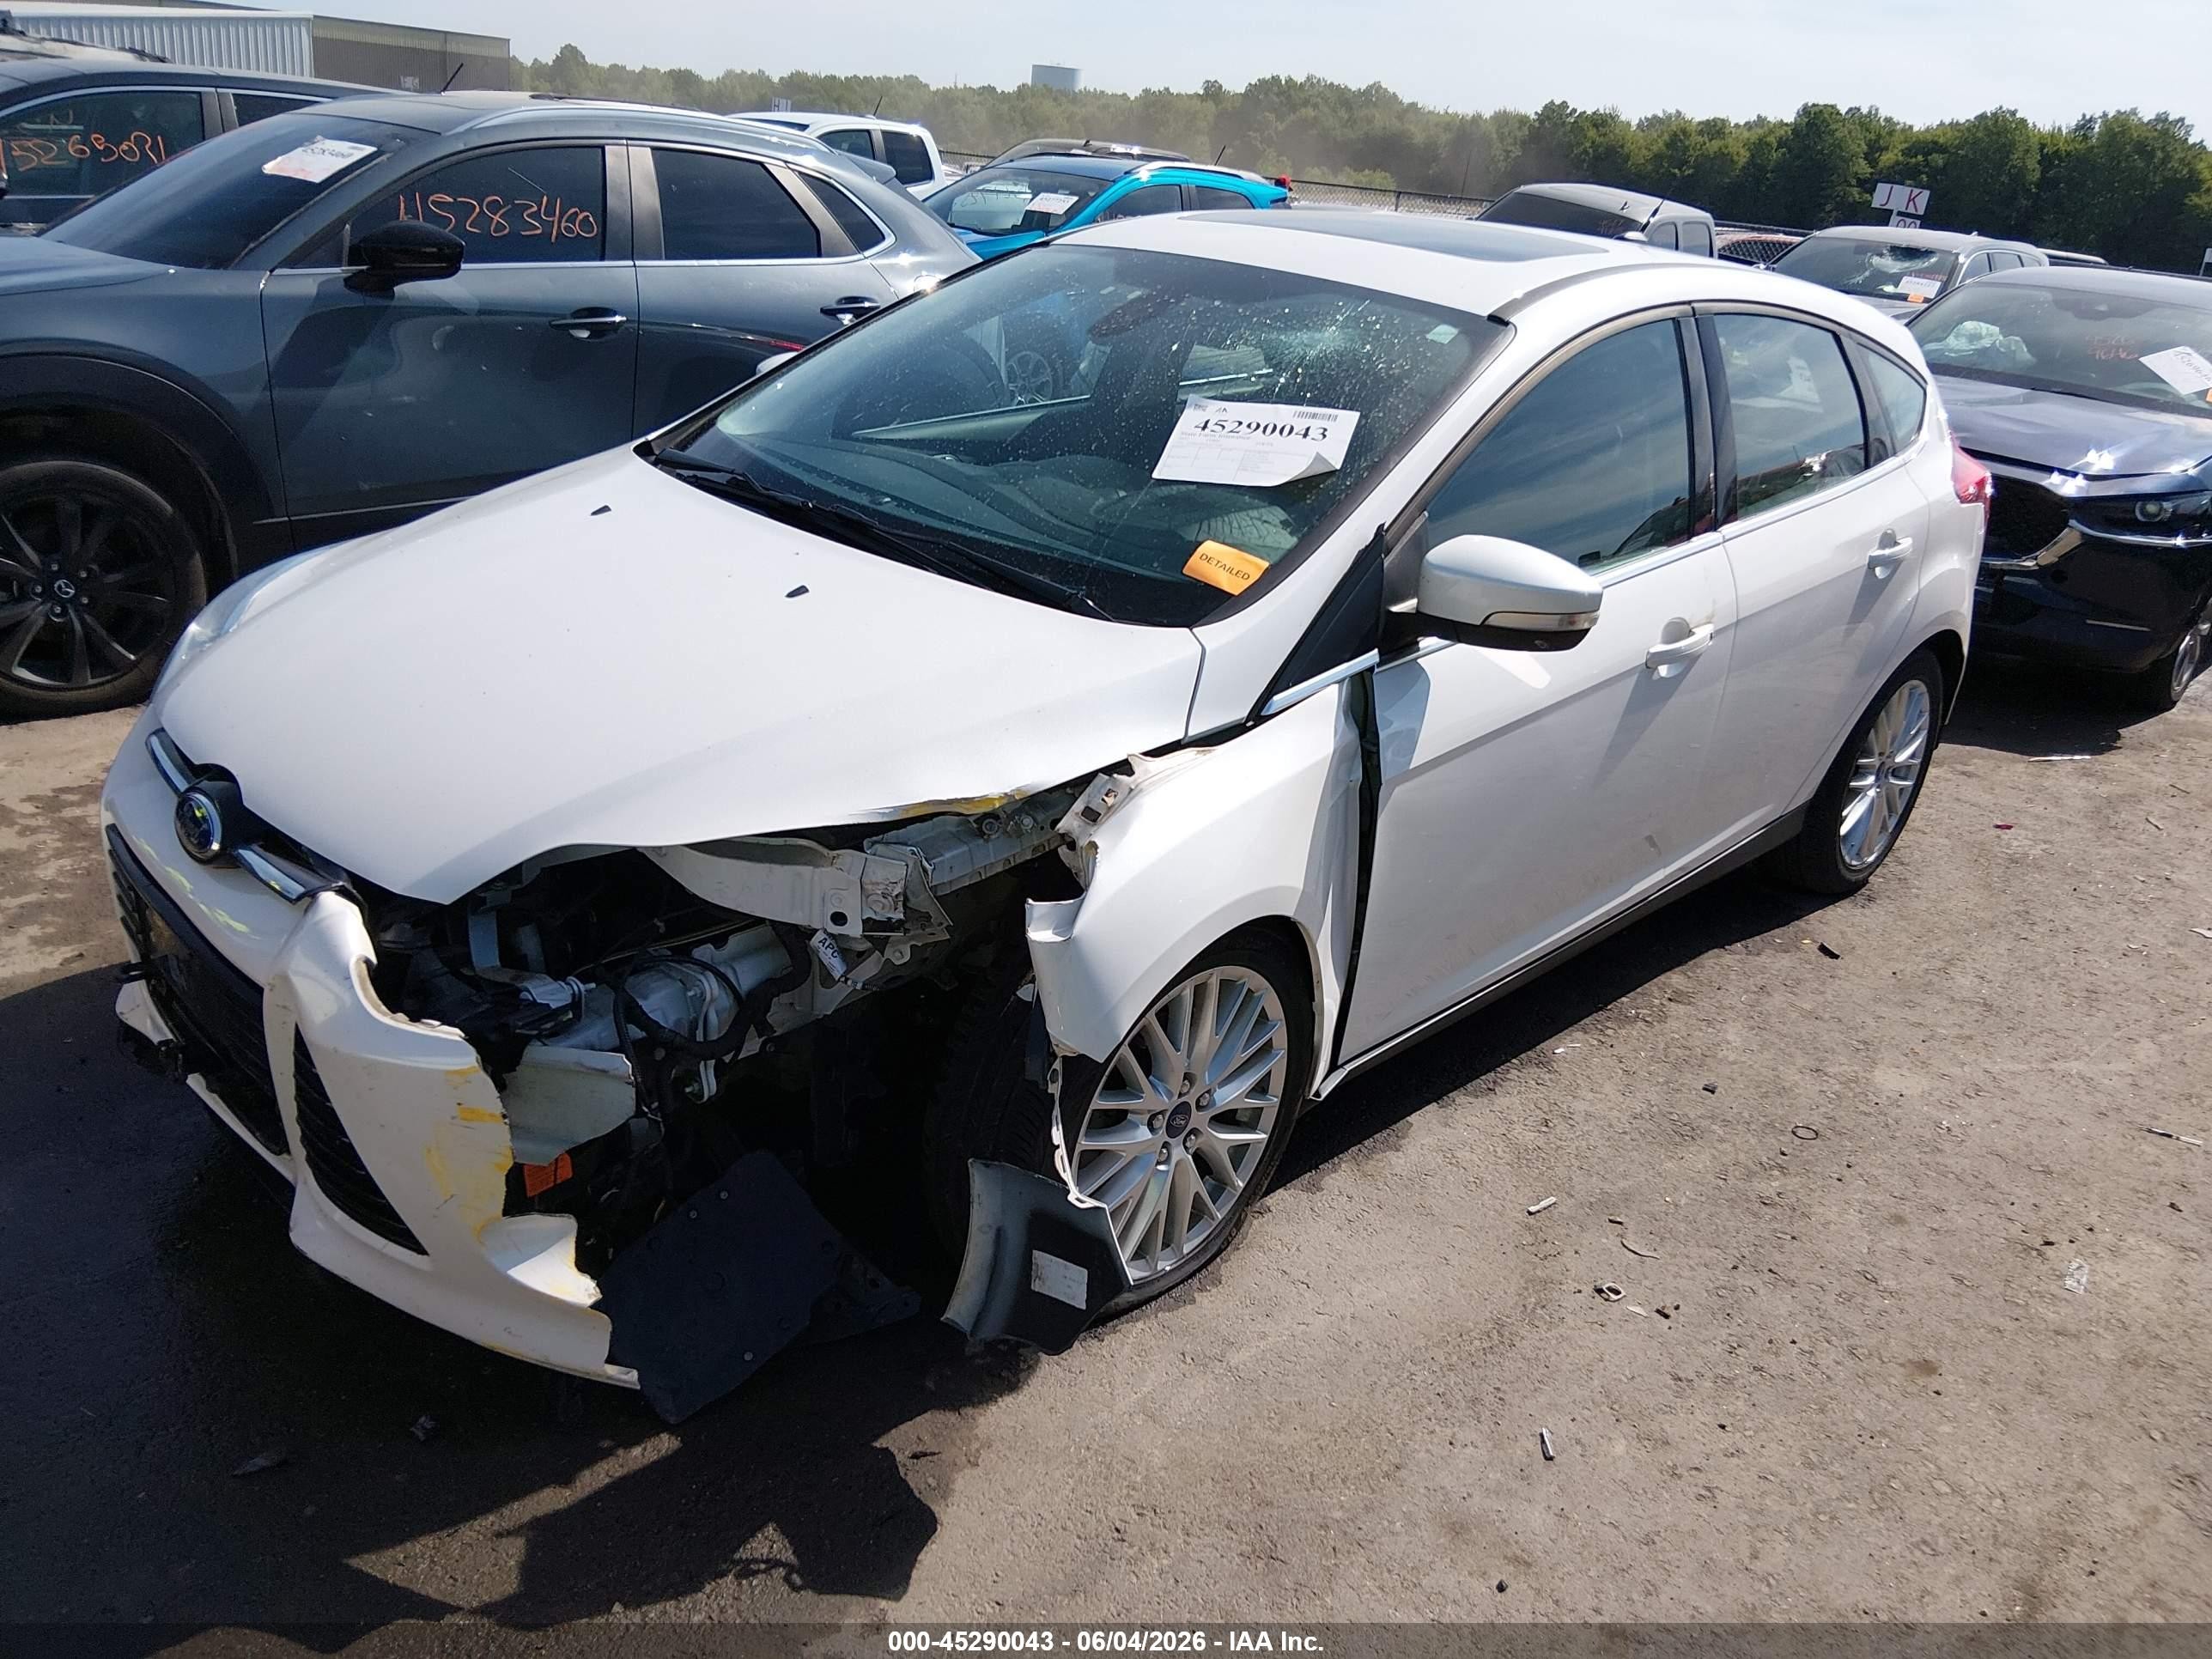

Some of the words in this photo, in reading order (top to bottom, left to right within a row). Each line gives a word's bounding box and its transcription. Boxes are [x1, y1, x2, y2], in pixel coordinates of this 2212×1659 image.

[1879, 185, 1893, 207] J
[1905, 189, 1923, 213] K
[1194, 418, 1328, 441] 45290043
[1199, 553, 1250, 580] DETAILED
